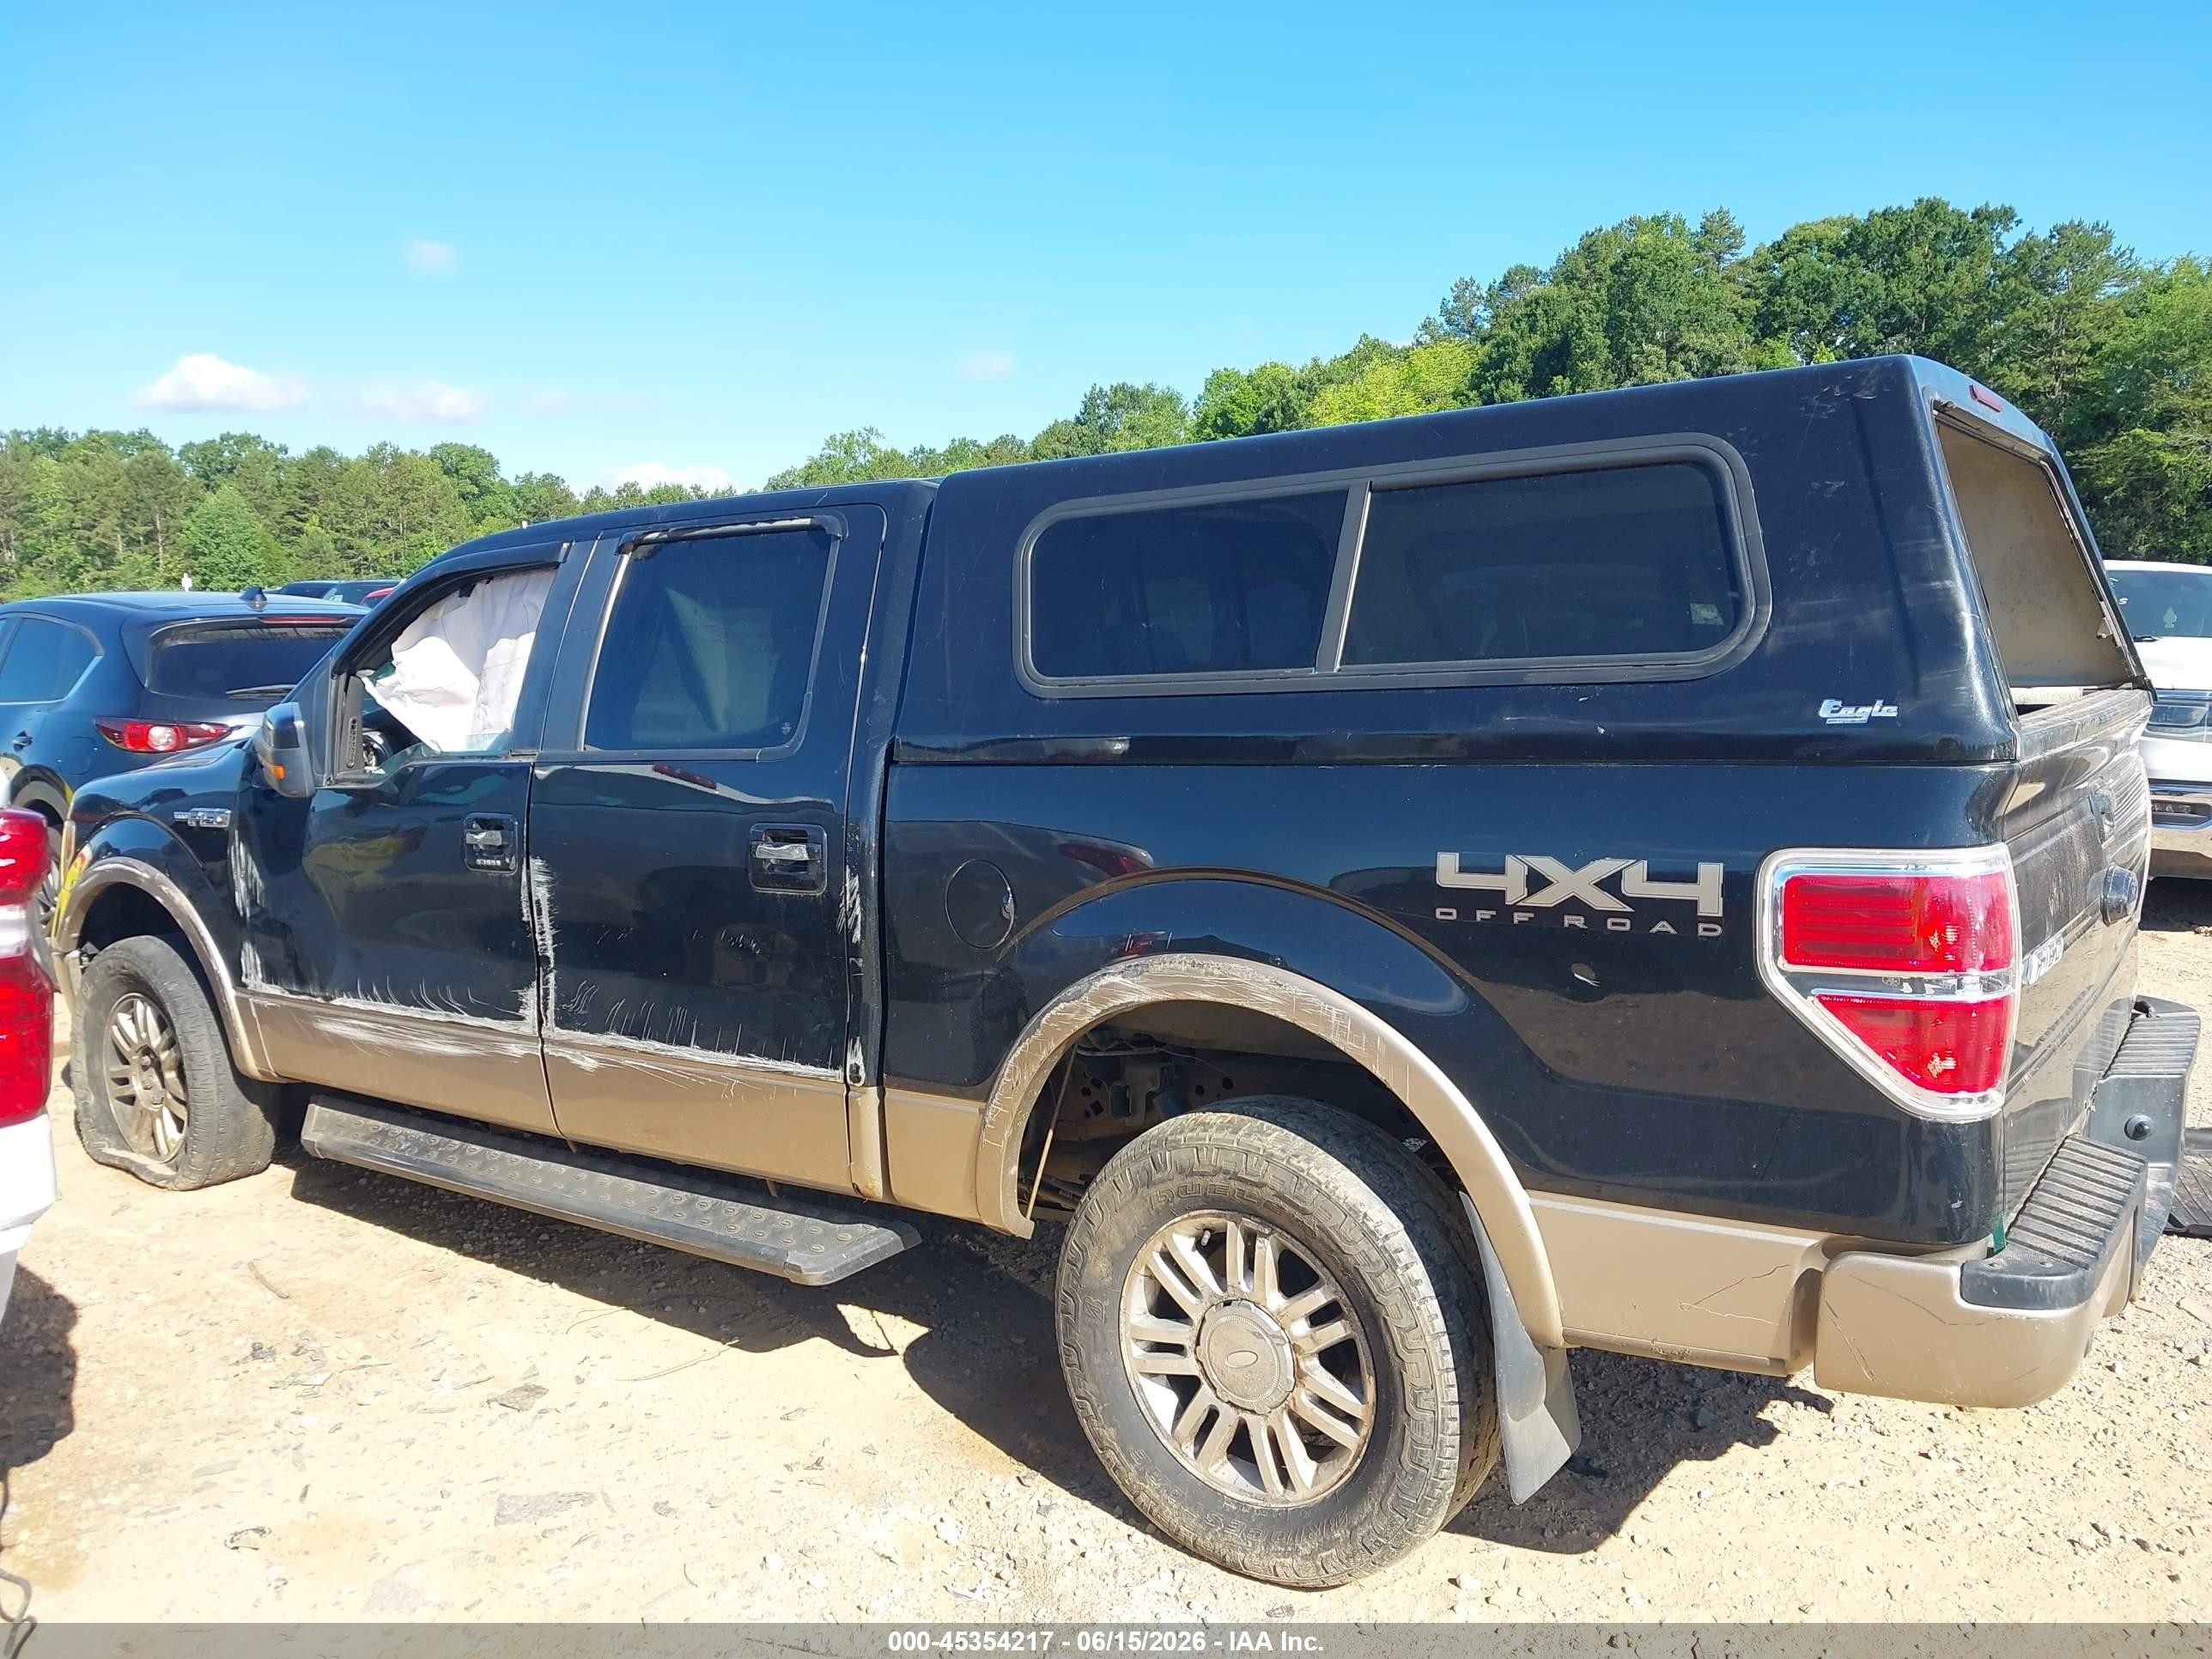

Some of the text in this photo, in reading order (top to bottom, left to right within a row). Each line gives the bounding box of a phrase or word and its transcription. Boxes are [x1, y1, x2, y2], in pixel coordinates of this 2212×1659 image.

[1819, 699, 1899, 724] Eagle
[1436, 908, 1723, 937] OFF ROAD
